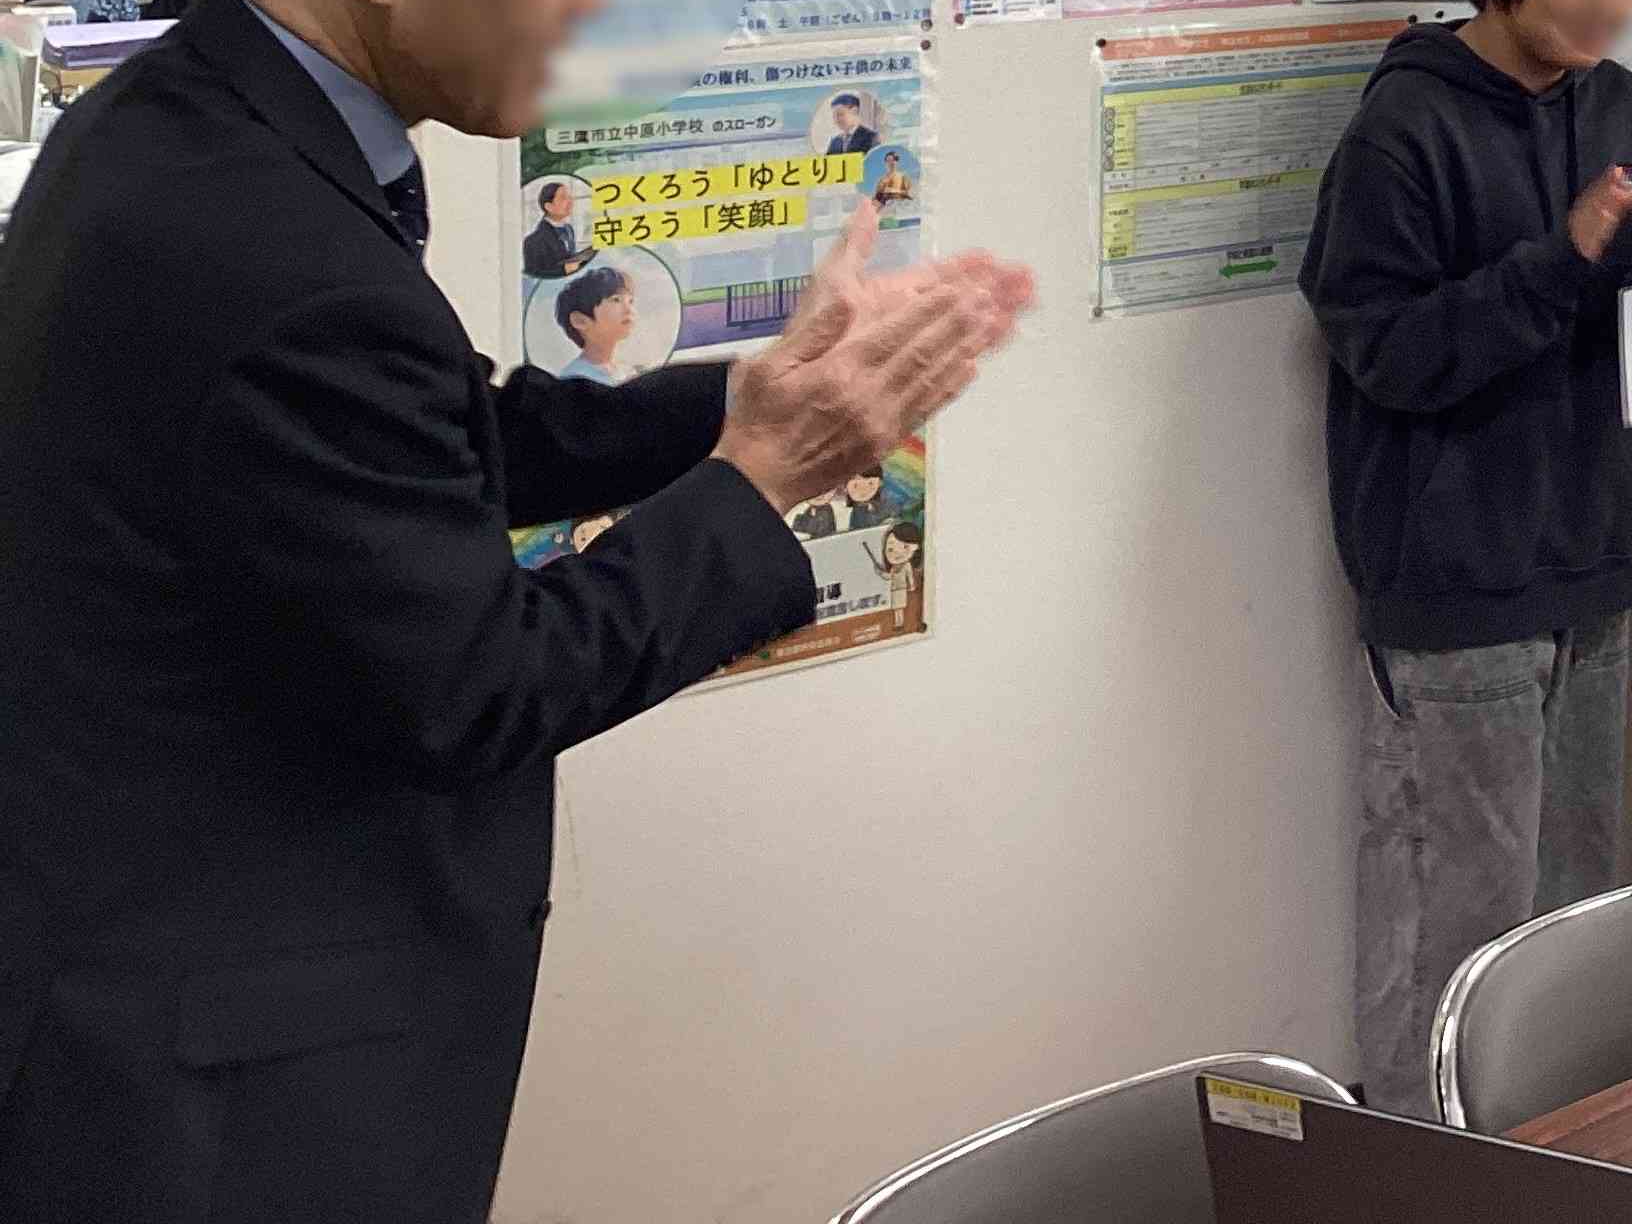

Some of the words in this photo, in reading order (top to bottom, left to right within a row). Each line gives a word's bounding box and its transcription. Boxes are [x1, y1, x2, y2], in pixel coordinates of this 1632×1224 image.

[557, 119, 705, 145] 三鷹市立中原小学校
[712, 115, 777, 132] のスローガン
[595, 157, 851, 206] つくろう「ゆとり」
[594, 199, 790, 247] 守ろう「笑顔」
